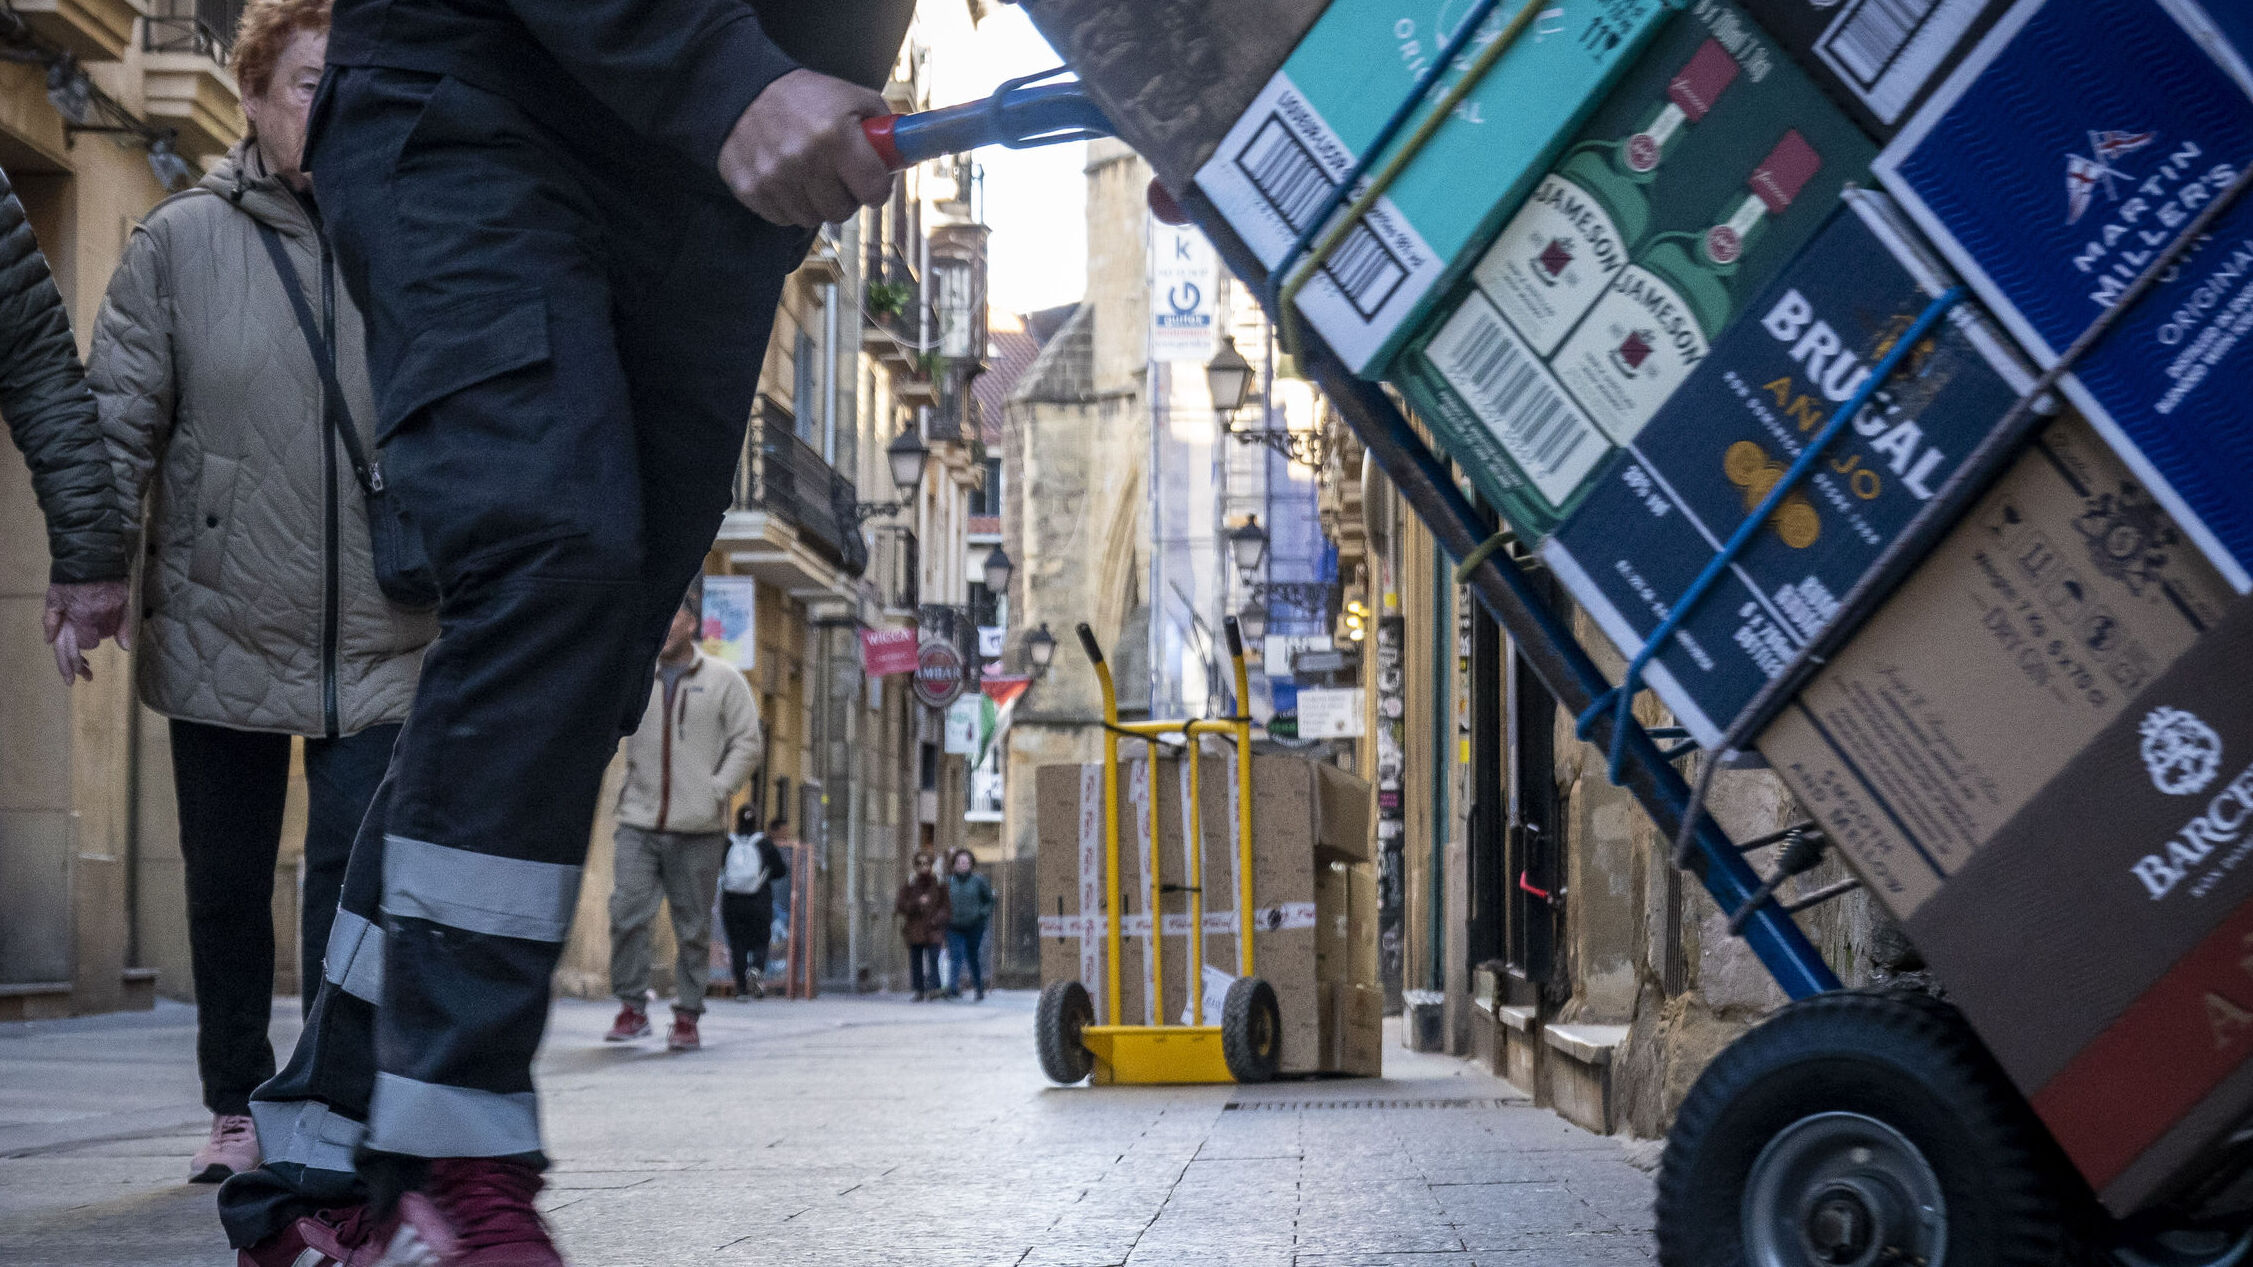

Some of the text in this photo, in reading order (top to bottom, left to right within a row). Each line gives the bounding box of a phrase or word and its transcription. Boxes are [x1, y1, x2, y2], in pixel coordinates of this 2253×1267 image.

[1535, 181, 1619, 274] JAMESON
[2071, 138, 2202, 274] MARTIN
[2088, 162, 2239, 306] MILLER'S
[1615, 272, 1703, 368] JAMESON
[1760, 286, 1944, 503] BRUGAL
[1762, 378, 1879, 497] AÑJO
